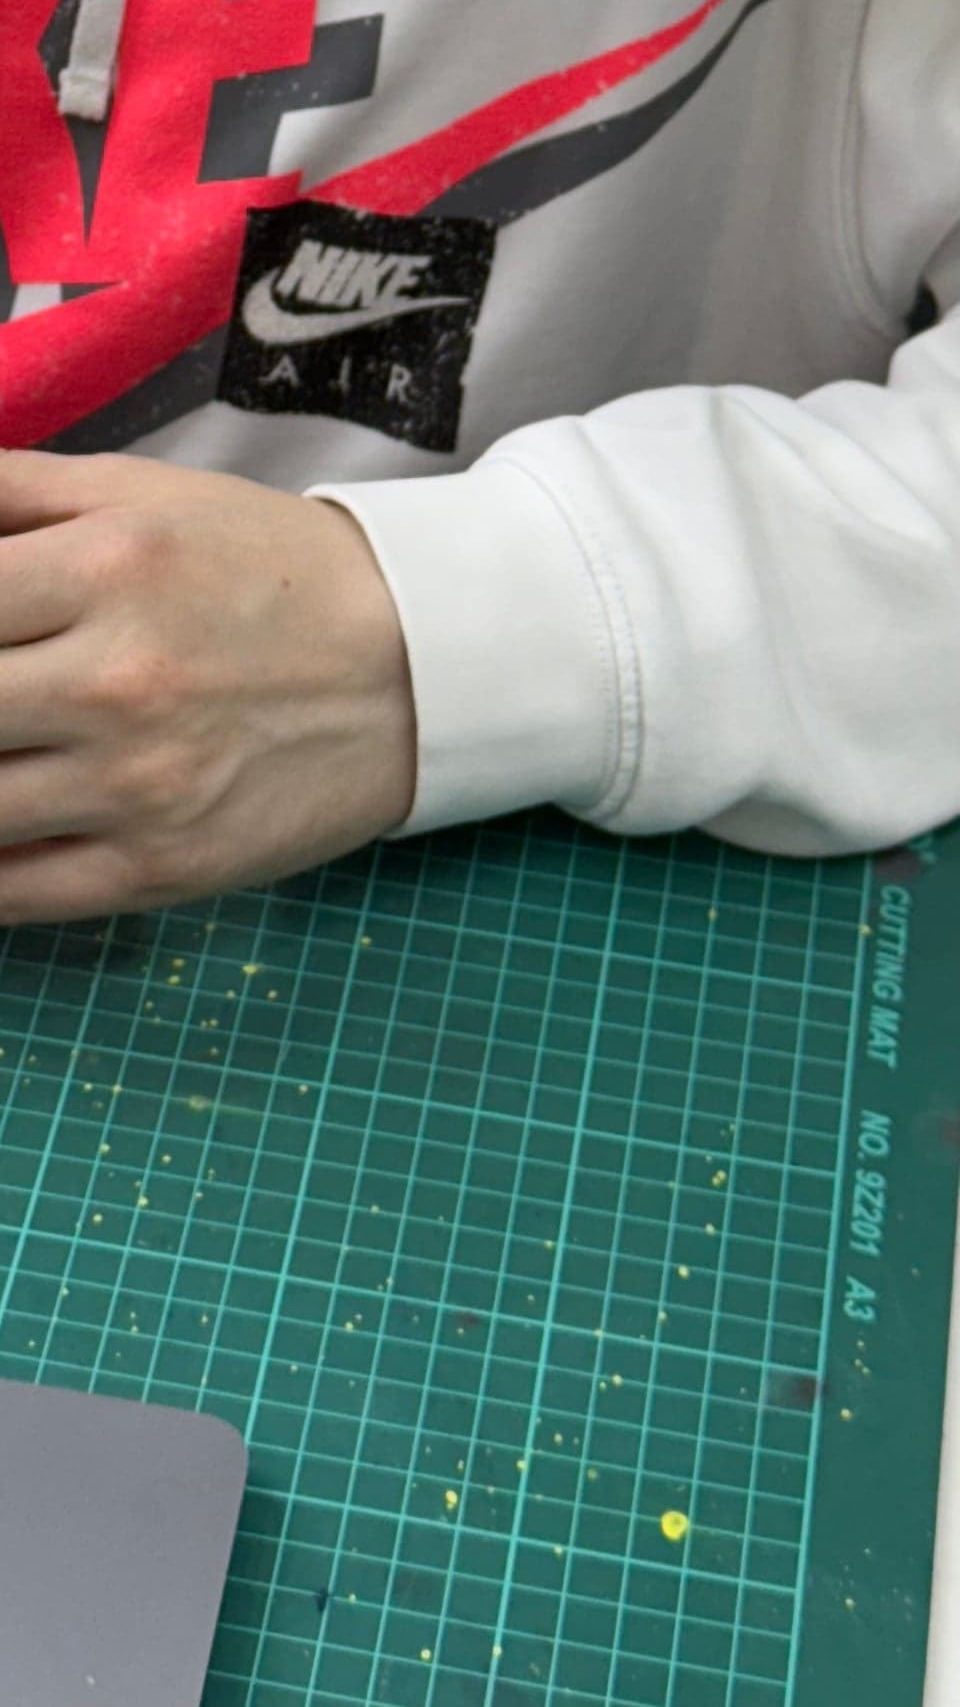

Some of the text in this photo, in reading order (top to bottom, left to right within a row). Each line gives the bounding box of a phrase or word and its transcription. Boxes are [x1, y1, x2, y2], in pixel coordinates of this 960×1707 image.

[275, 238, 433, 310] NIKE
[257, 354, 413, 403] AIR
[872, 885, 911, 1002] CUTTING
[866, 1005, 901, 1070] MAT
[856, 1109, 892, 1161] NO.
[843, 1274, 876, 1324] A3
